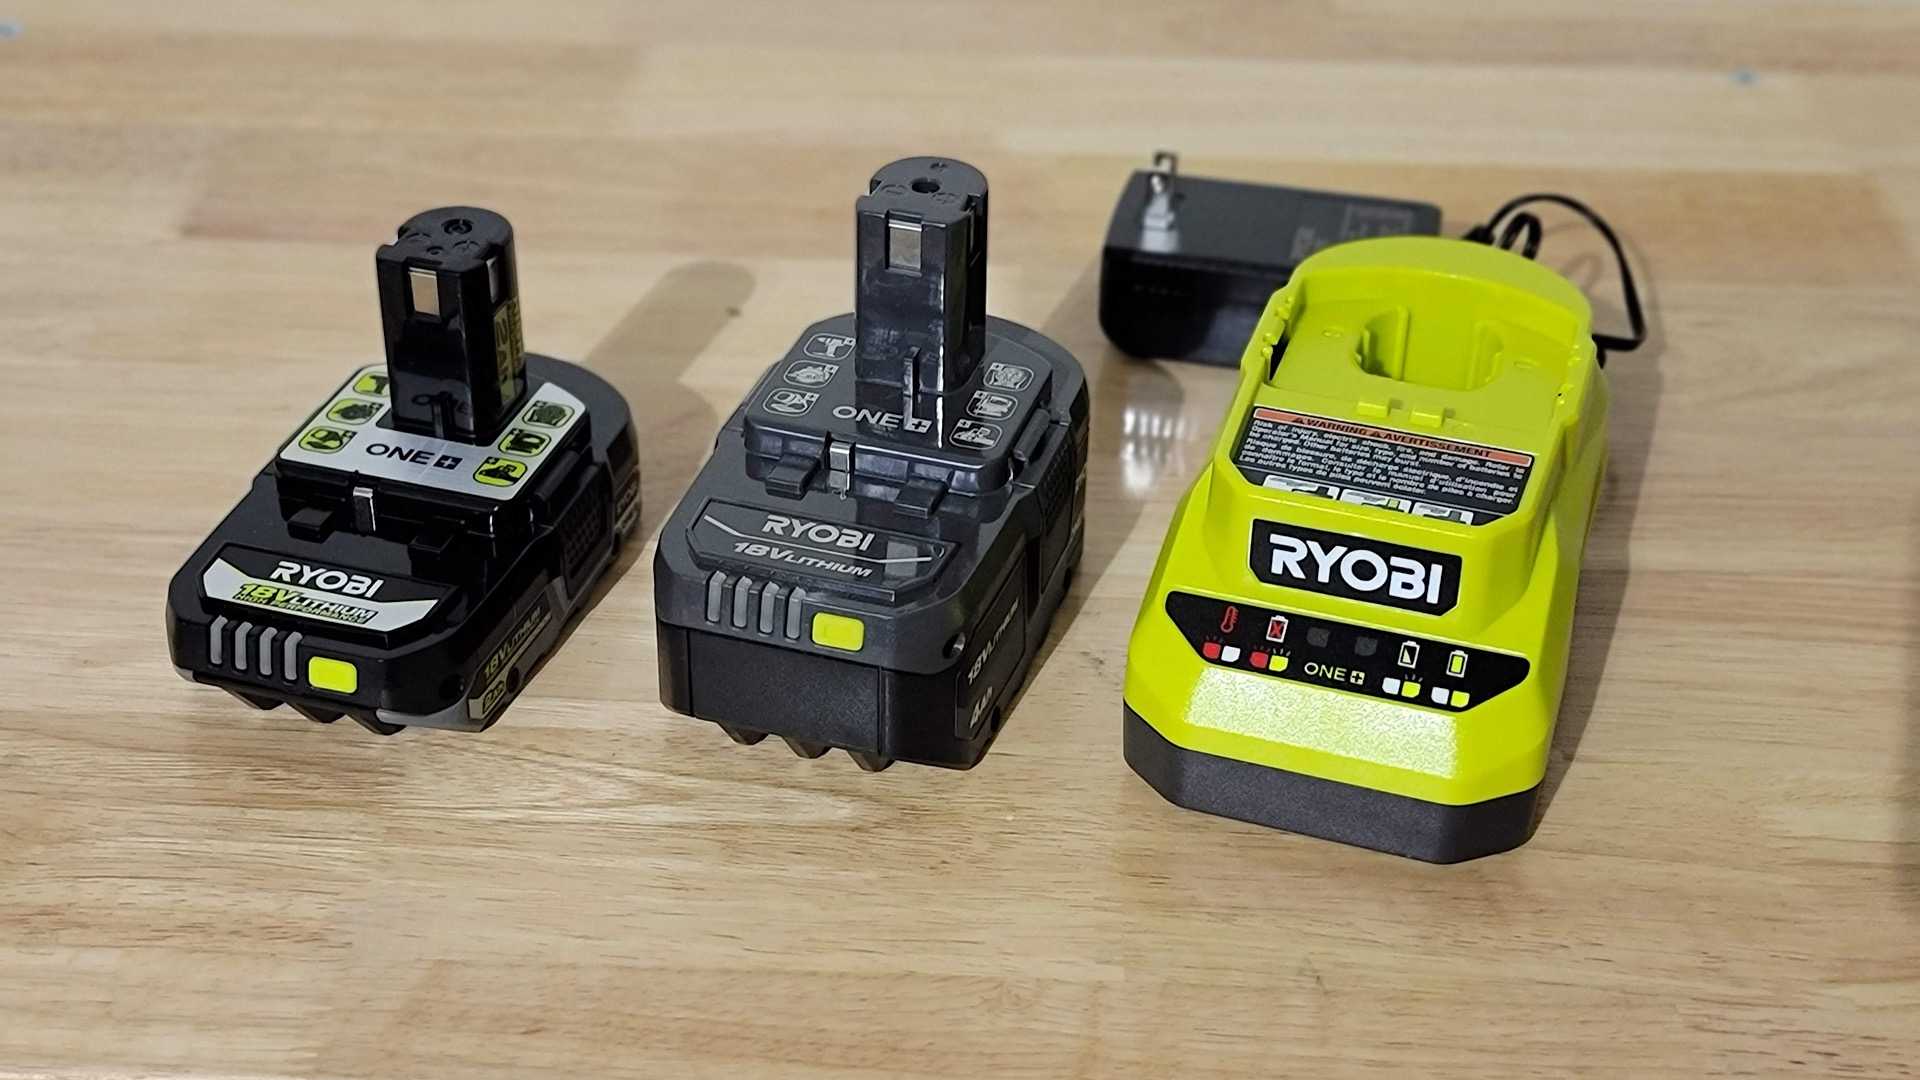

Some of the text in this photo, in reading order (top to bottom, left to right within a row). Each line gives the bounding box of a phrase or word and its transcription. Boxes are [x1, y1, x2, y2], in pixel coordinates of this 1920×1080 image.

[1305, 419, 1491, 457] WARNING AVERTISSEMENT
[762, 514, 875, 551] RYOBI
[270, 560, 385, 599] RYOBI
[1269, 533, 1443, 604] RYOBI
